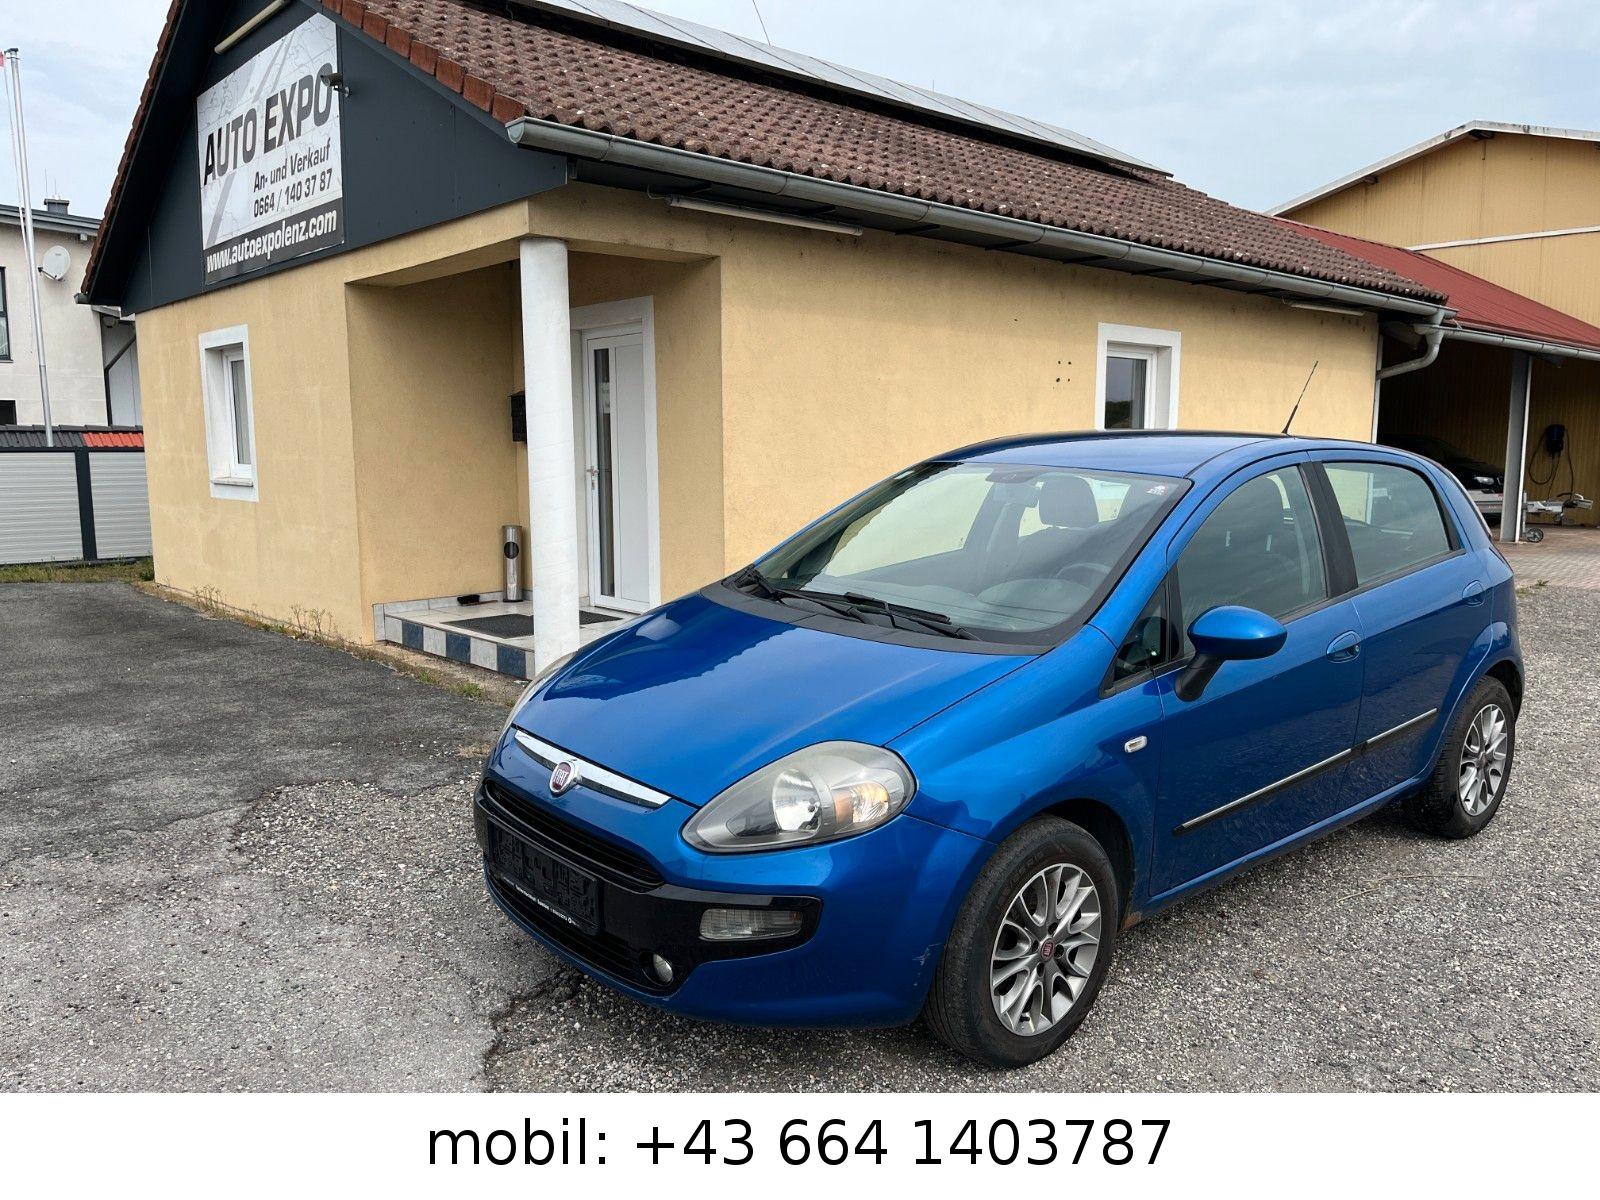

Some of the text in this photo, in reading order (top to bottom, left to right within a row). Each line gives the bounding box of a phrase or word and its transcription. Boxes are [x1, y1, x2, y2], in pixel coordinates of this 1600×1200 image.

[204, 62, 333, 186] AUTO EXPO
[253, 137, 331, 193] An- und Verkauf
[254, 192, 275, 218] 0664
[285, 181, 303, 206] 140
[304, 174, 317, 198] 37
[319, 168, 333, 192] 87
[206, 209, 337, 274] www.autoexpolenz.com
[554, 768, 570, 786] FIAT
